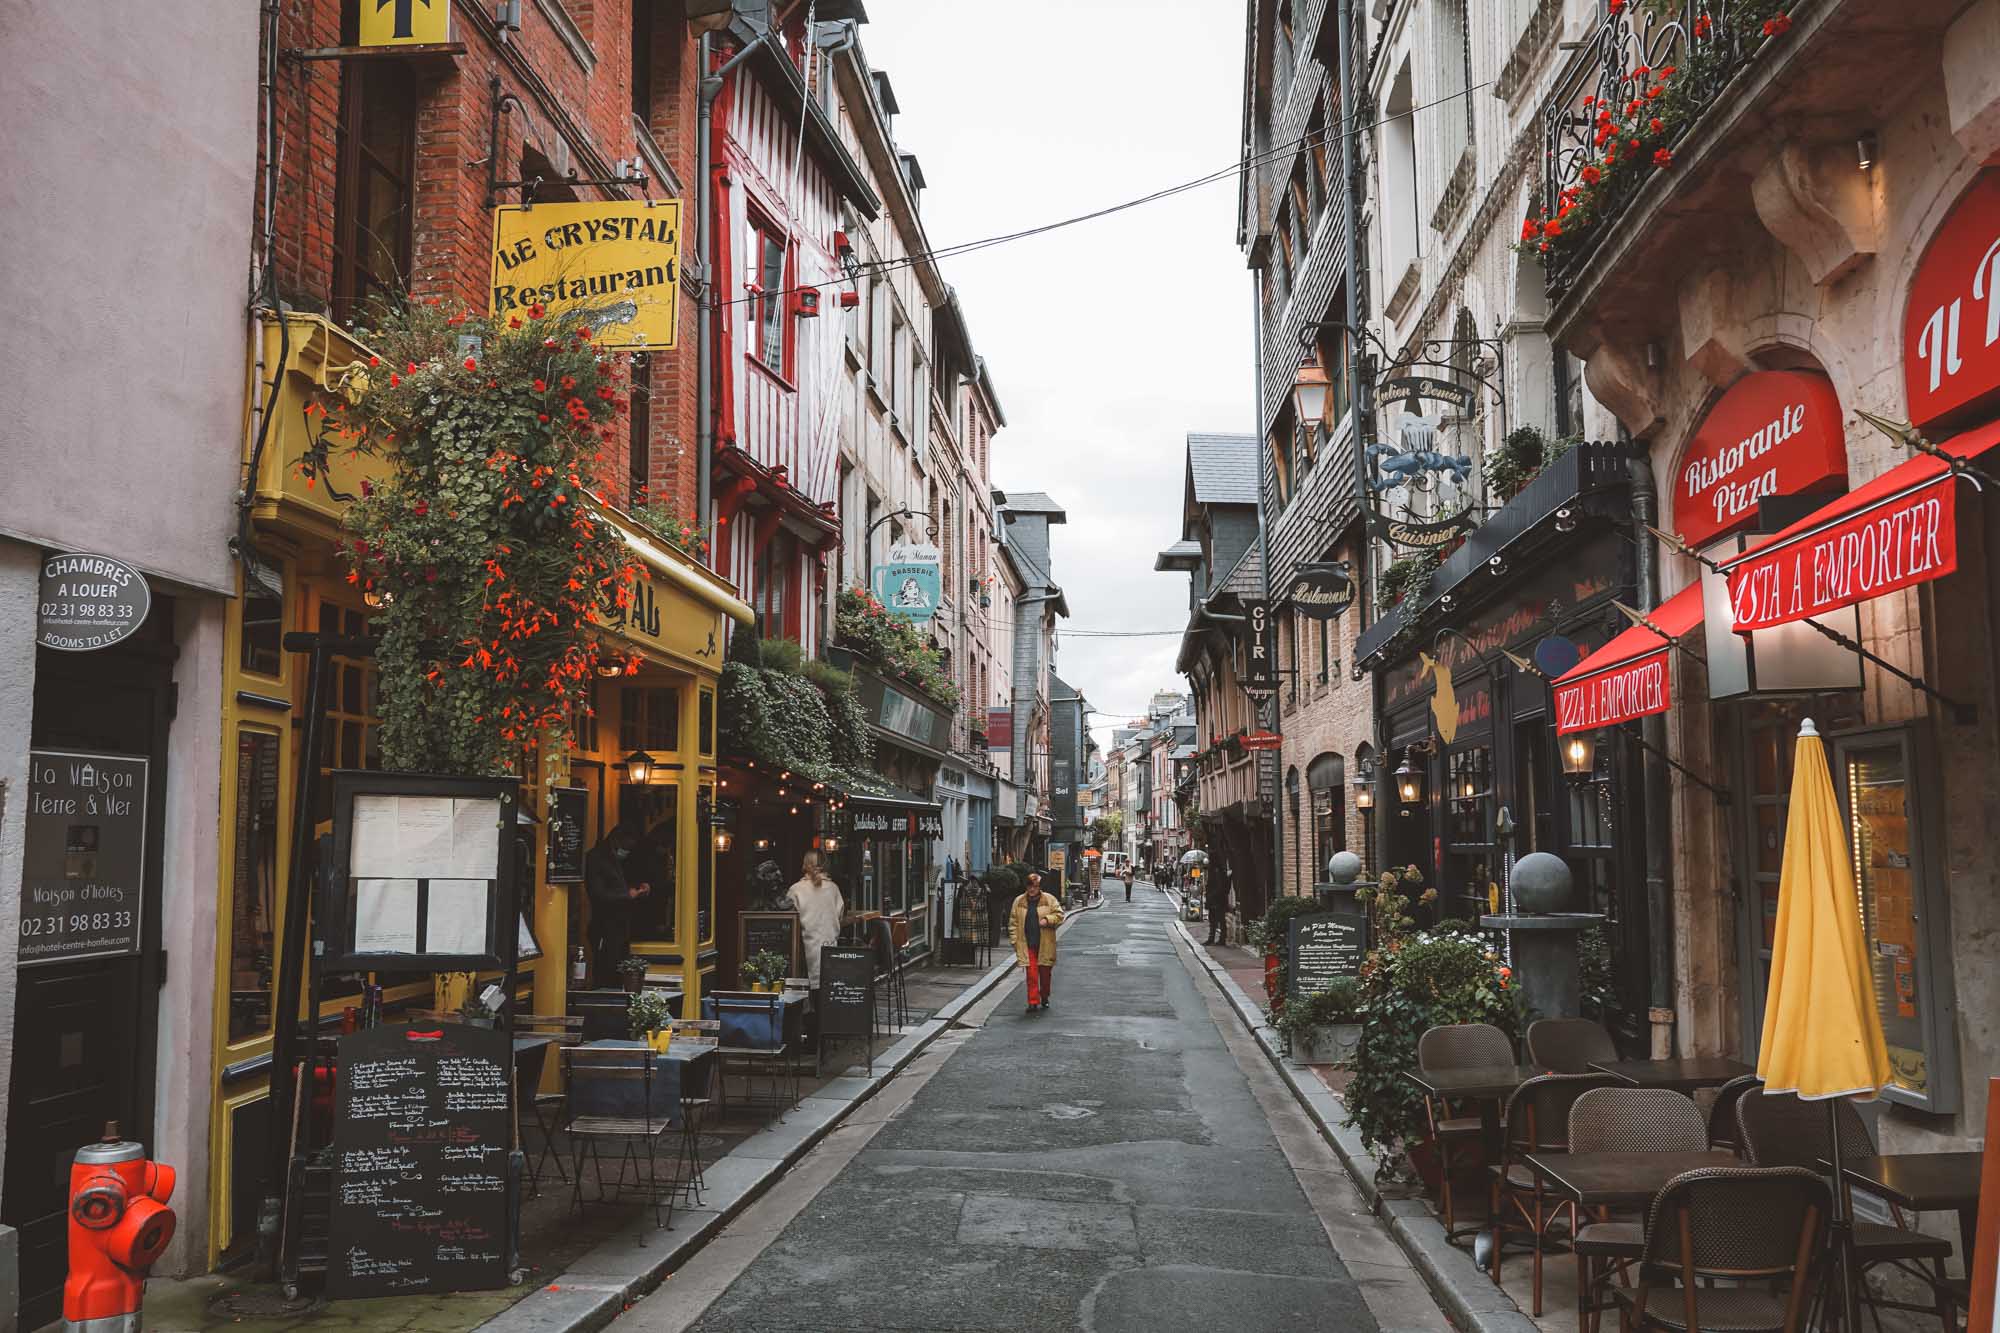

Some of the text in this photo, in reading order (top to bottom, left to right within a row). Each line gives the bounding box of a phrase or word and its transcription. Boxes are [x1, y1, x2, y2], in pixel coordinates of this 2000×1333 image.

[498, 217, 675, 271] LE CRYSTAL
[493, 257, 677, 312] Restaurant
[1918, 297, 1962, 393] Il
[1685, 403, 1805, 498] Ristorante
[1712, 467, 1778, 523] Pizza
[1388, 522, 1459, 546] Cuisinier
[912, 551, 937, 561] Maman
[1789, 552, 1804, 615] A
[1812, 498, 1943, 608] EMPORTER
[46, 558, 133, 587] CHAMBRES
[891, 567, 935, 577] BRASSERIE
[58, 584, 118, 598] A LOUER
[41, 603, 133, 618] 02 31 98 83 33
[44, 626, 122, 648] ROOMS TO LET
[1252, 606, 1265, 659] CUIR
[1254, 672, 1265, 681] du
[1588, 681, 1597, 724] A
[1600, 661, 1663, 722] EMPORTER
[34, 761, 56, 784] La
[34, 792, 131, 816] Terre & Mer
[33, 886, 75, 907] Maison
[21, 911, 131, 937] 02 31 98 83 33
